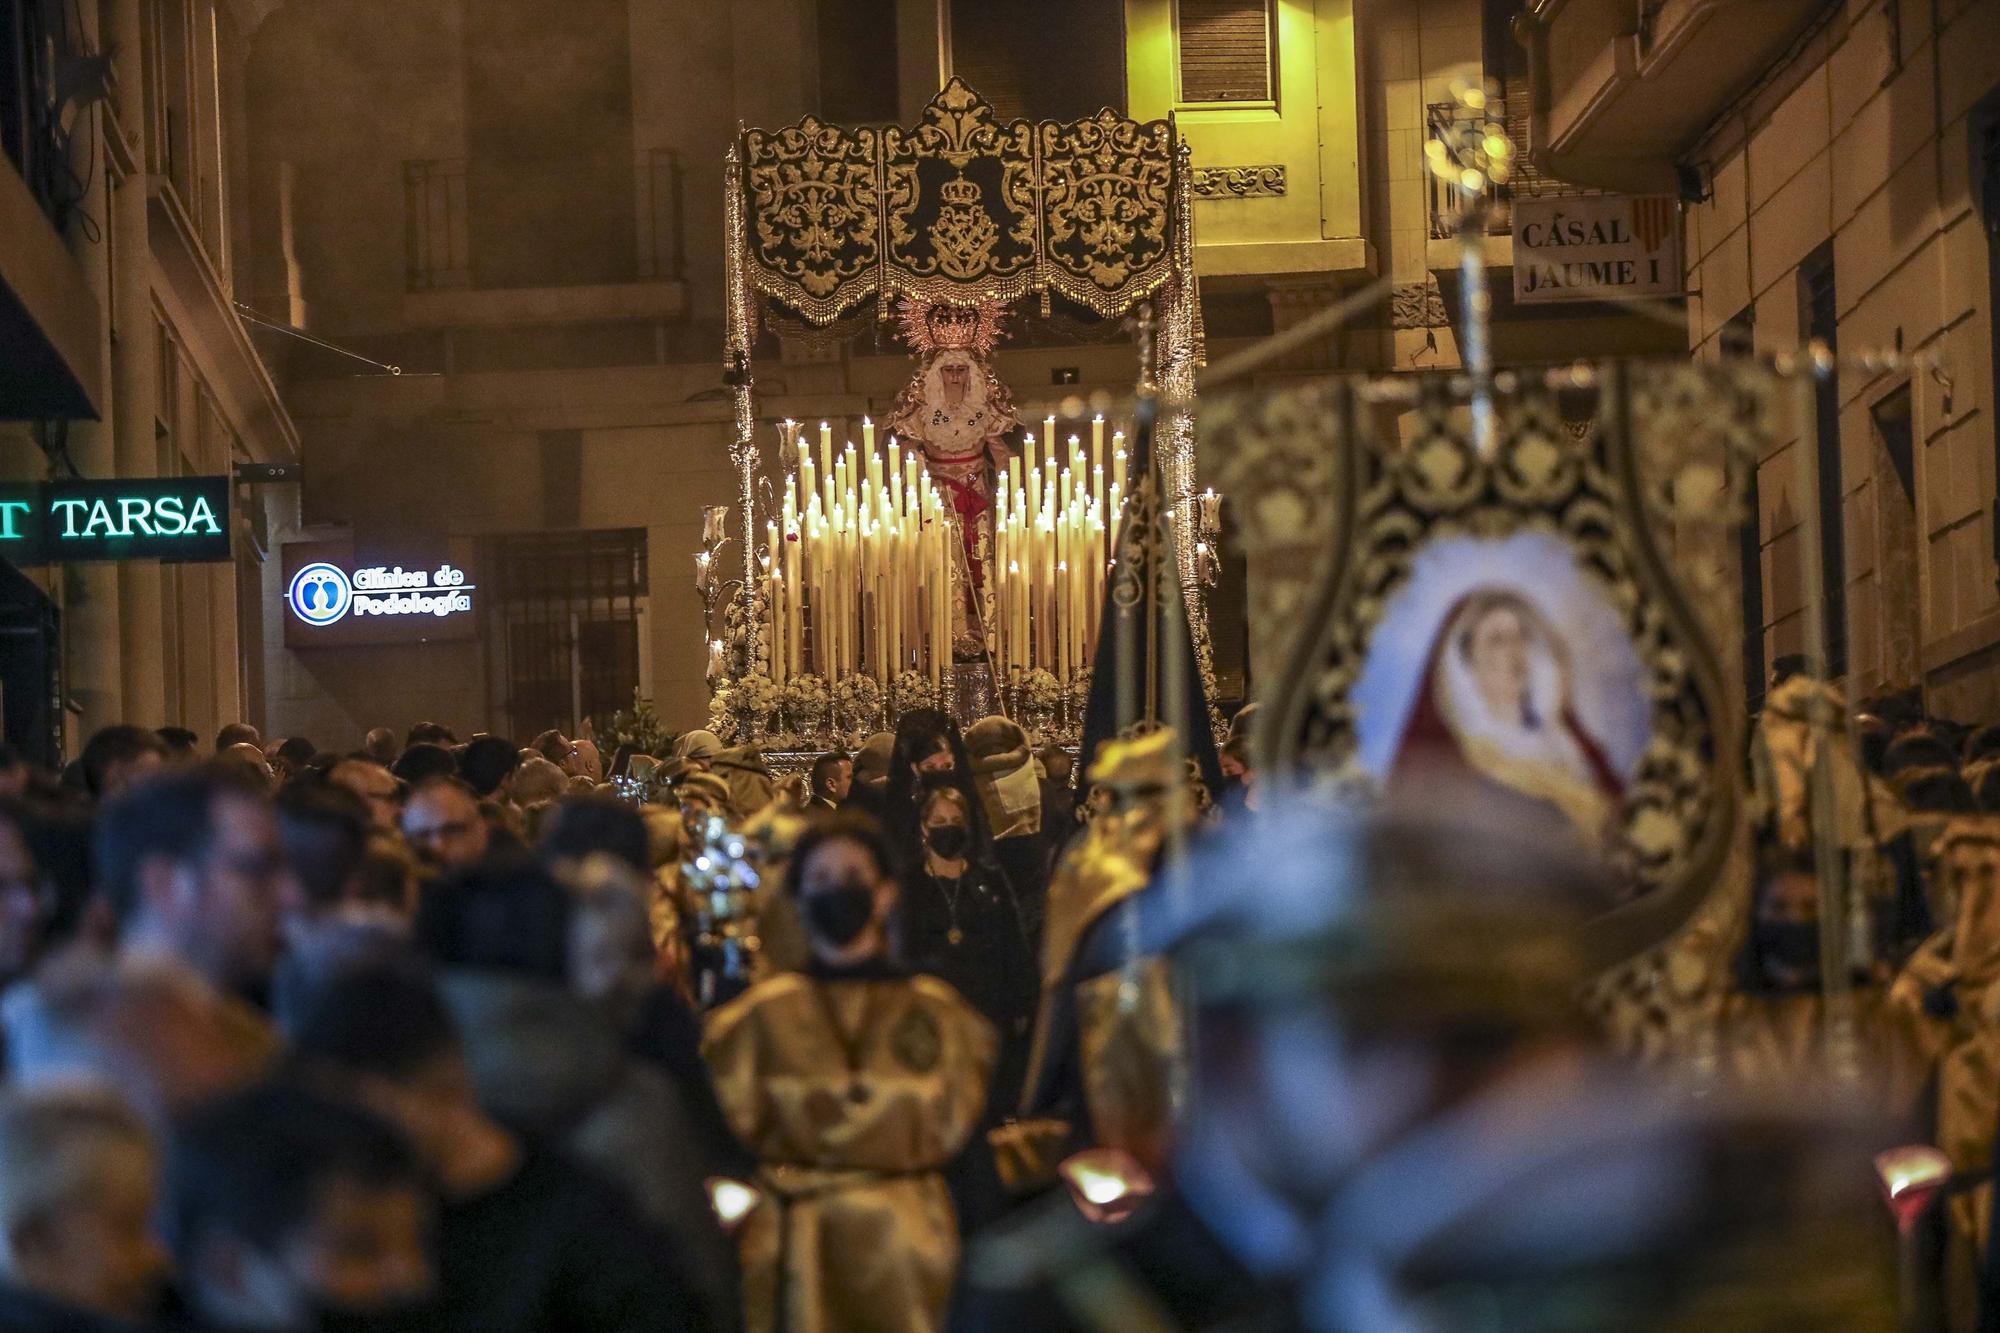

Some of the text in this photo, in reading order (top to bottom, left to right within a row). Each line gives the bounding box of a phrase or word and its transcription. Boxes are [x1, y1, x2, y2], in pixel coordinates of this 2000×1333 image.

[1524, 258, 1660, 293] JAUME I
[51, 496, 222, 537] TARSA
[353, 565, 464, 589] Clínica de
[354, 590, 471, 616] Podología
